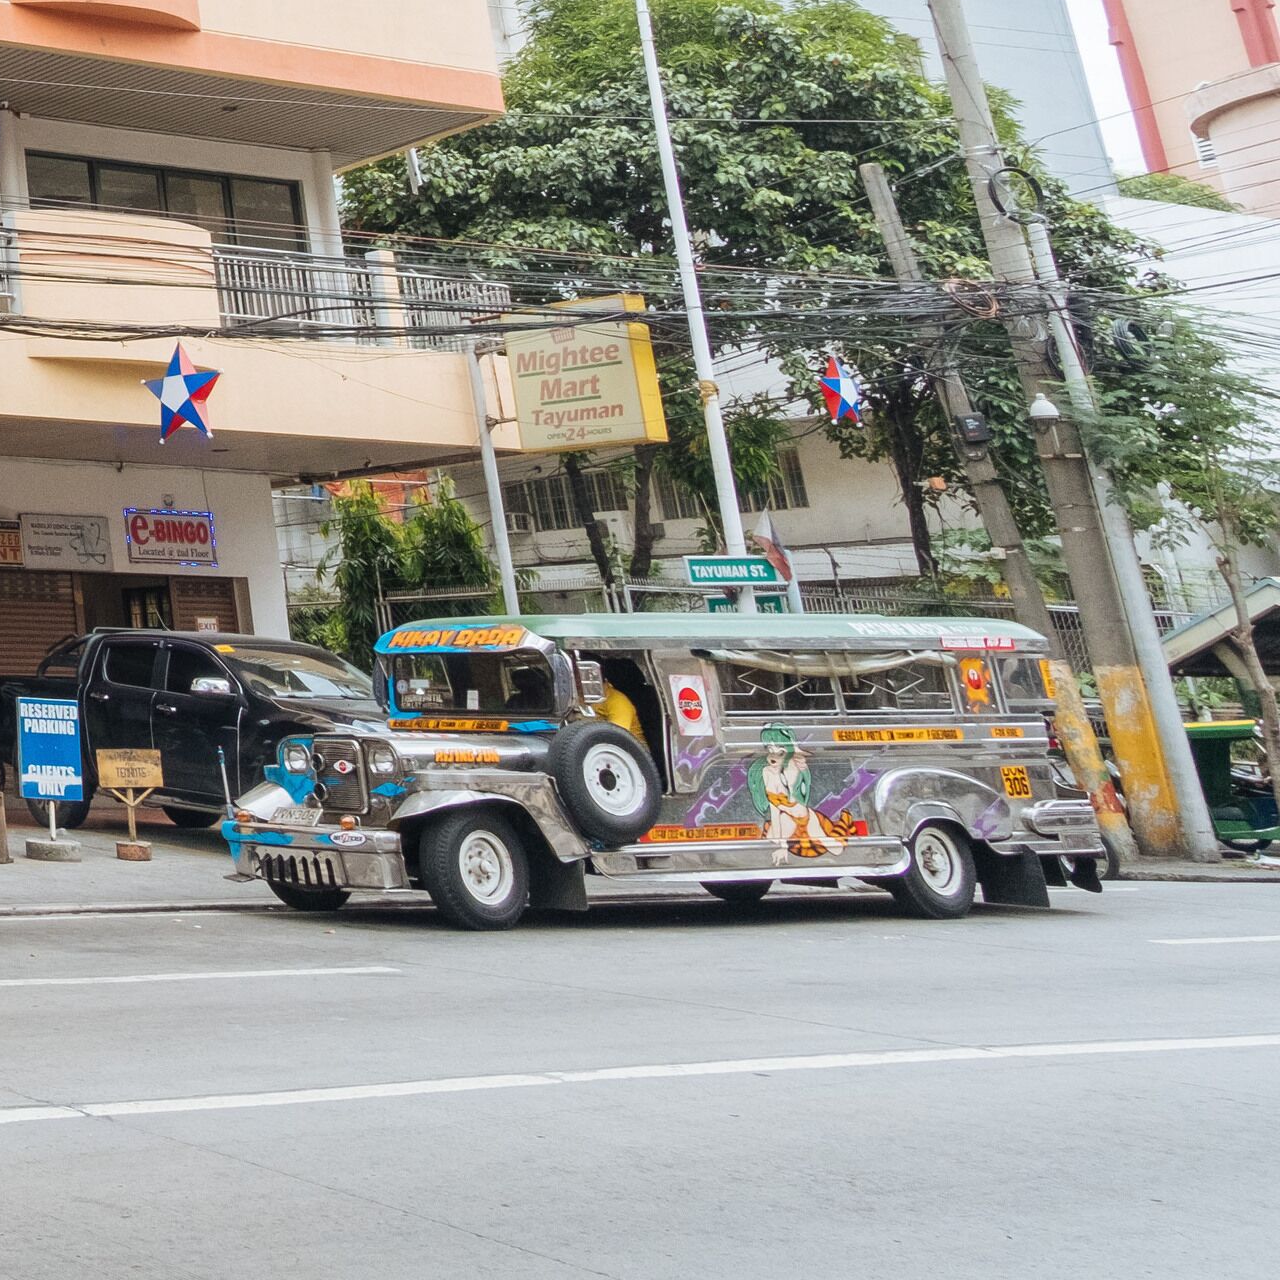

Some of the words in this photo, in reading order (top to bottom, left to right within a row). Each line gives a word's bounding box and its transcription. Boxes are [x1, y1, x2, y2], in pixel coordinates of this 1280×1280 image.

[516, 343, 620, 376] Mightee
[540, 374, 600, 400] Mart
[531, 403, 624, 429] Tayuman
[566, 426, 586, 441] 24
[130, 515, 209, 545] e-BINGO
[138, 547, 166, 557] Located
[190, 549, 209, 558] Floor
[692, 565, 748, 578] TAYUMAN
[750, 564, 768, 577] ST.
[199, 622, 218, 630] EXIT
[20, 703, 79, 720] RESERVED
[24, 718, 76, 736] PARKING
[27, 764, 76, 777] CLIENTS
[1005, 776, 1029, 797] 306
